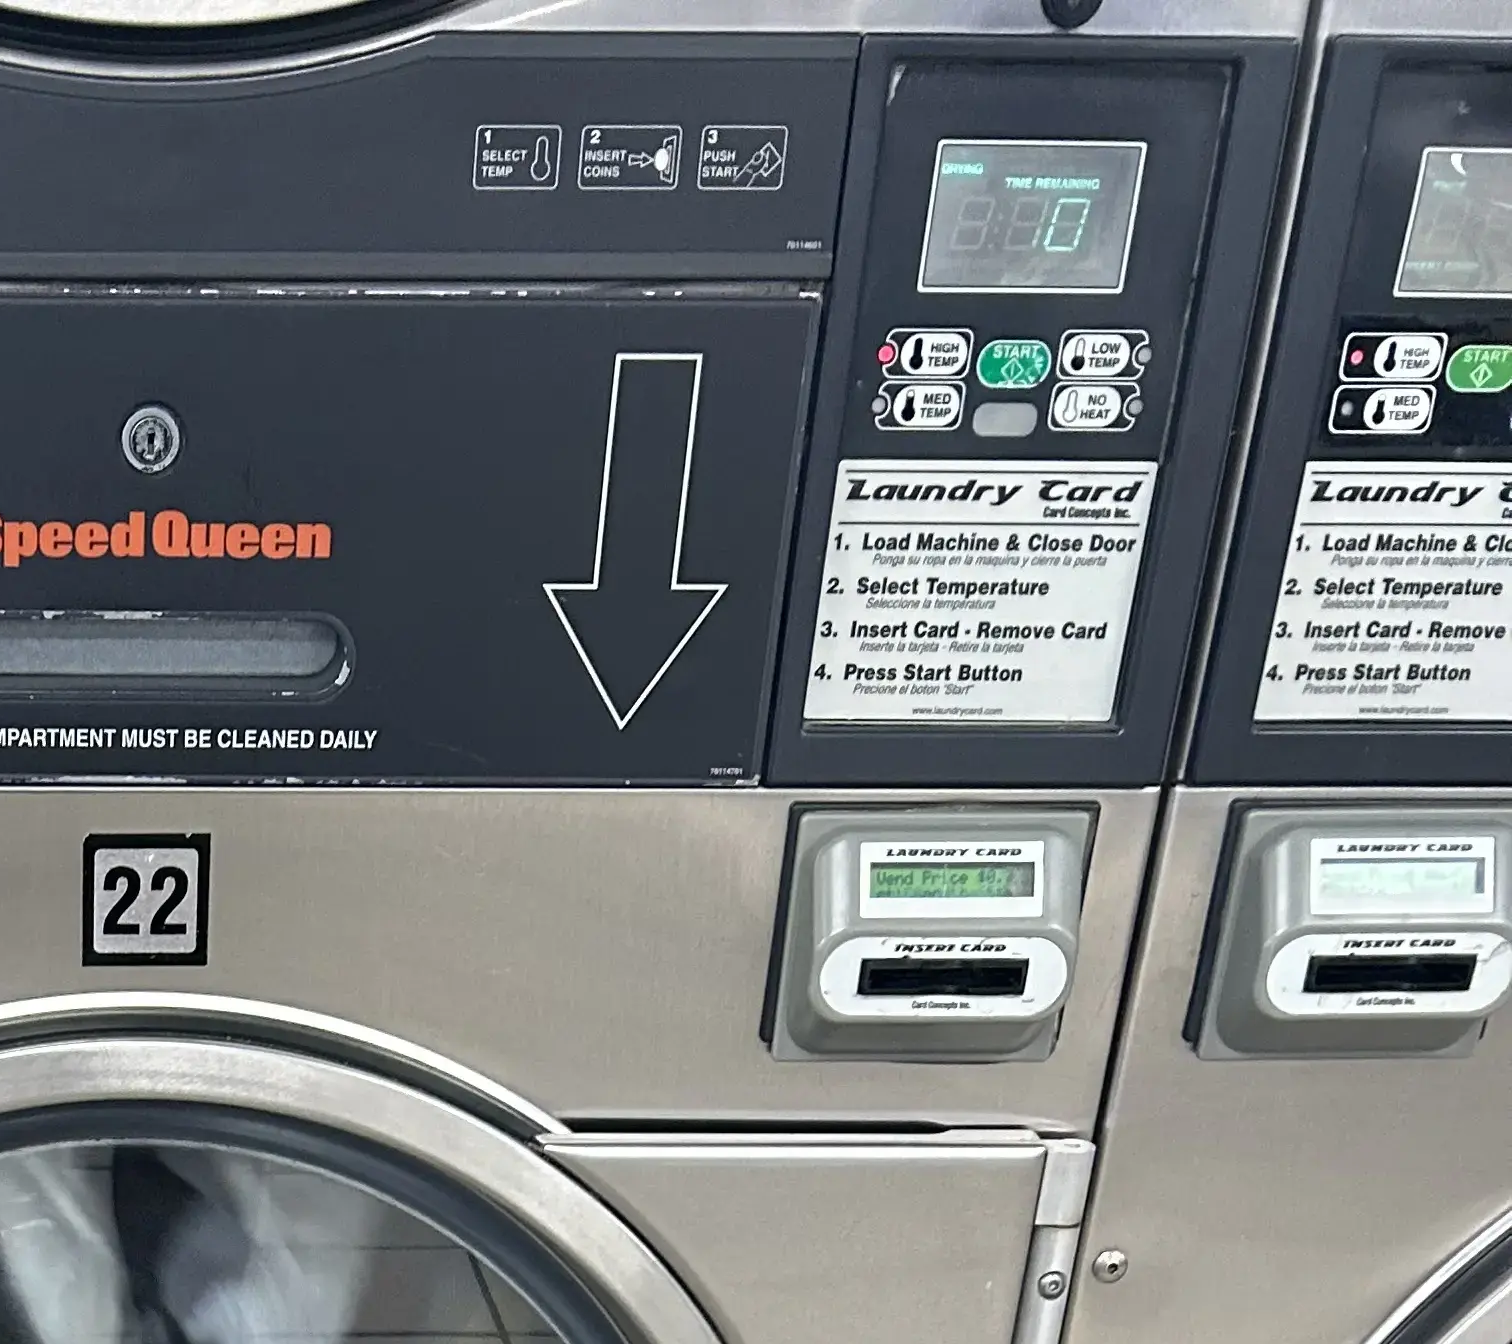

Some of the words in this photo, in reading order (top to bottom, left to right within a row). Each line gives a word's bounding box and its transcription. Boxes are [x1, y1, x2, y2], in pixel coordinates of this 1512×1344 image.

[1004, 177, 1032, 189] TIME
[1035, 177, 1100, 190] REMAINING
[931, 343, 959, 353] HIGH
[993, 344, 1041, 360] START
[1404, 348, 1429, 357] HIGH
[928, 356, 958, 367] TEMP
[1464, 348, 1510, 363] START
[1401, 359, 1429, 369] TEMP
[1394, 396, 1420, 406] MED
[1389, 411, 1419, 420] TEMP
[846, 479, 1023, 506] Laundry
[1039, 480, 1142, 502] Card
[1310, 481, 1484, 507] Laundry
[153, 511, 331, 559] Queen
[835, 533, 849, 550] 1.
[862, 533, 911, 550] Load
[916, 533, 999, 551] Machine
[1006, 534, 1020, 551] &
[1028, 534, 1083, 552] Close
[1089, 535, 1136, 552] Door
[1284, 578, 1301, 595] 2.
[1314, 578, 1375, 595] Select
[1383, 578, 1503, 599] Temperature
[1266, 665, 1283, 681] 4.
[1295, 664, 1347, 680] Press
[1353, 664, 1400, 680] Start
[1407, 664, 1471, 681] Button
[122, 729, 178, 748] MUST
[185, 729, 211, 747] BE
[218, 729, 314, 748] CLEANED
[320, 730, 377, 748] DAILY
[1338, 844, 1419, 852] LAUNDRY
[876, 872, 914, 885] Vend
[922, 871, 968, 885] Price
[103, 866, 188, 935] 22
[895, 944, 955, 952] INSERT
[960, 944, 1006, 952] CARD
[1343, 940, 1404, 948] INSERT
